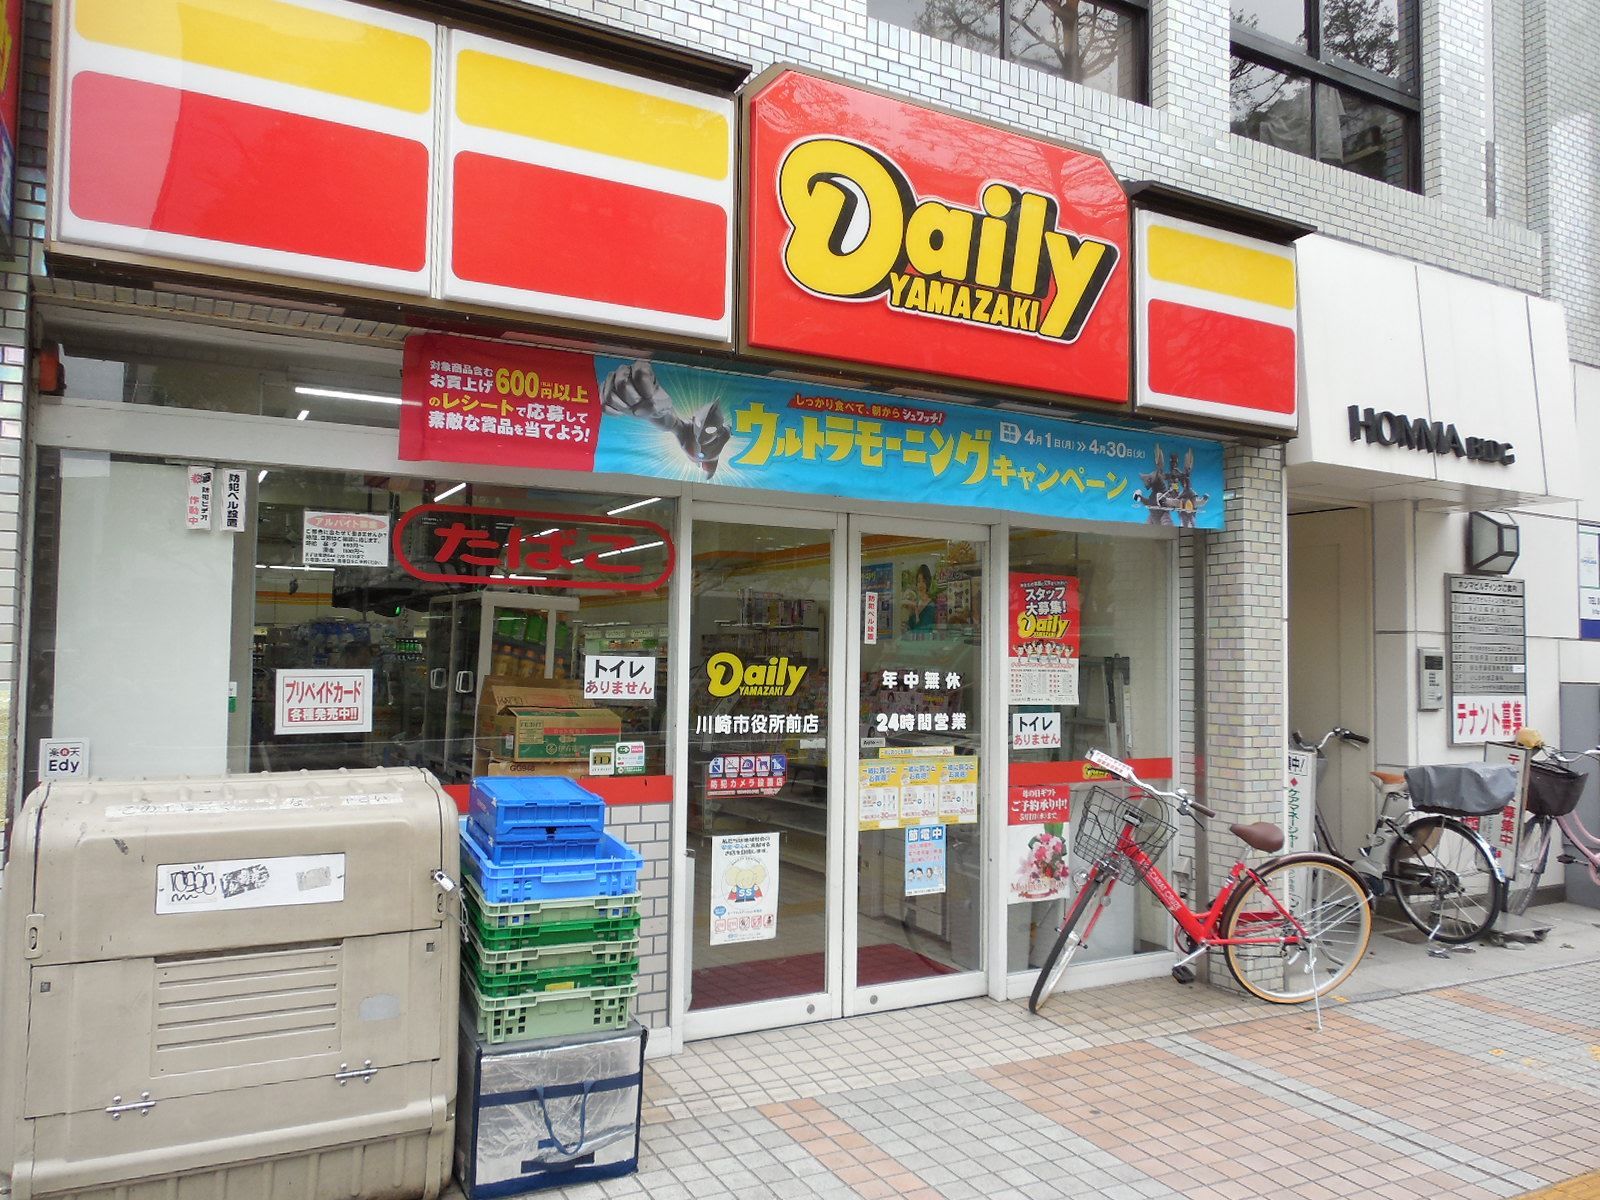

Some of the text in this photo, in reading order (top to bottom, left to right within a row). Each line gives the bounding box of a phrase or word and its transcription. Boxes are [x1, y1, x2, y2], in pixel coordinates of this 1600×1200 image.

[776, 135, 1120, 343] Daily
[888, 271, 1042, 333] YAMAZAKI
[430, 360, 494, 377] 対象商品含む
[734, 402, 992, 486] ウルトラモーニング
[992, 454, 1128, 500] キャンペーン
[434, 522, 642, 574] たばこ
[1025, 587, 1066, 601] スタッフ
[1018, 611, 1070, 638] Daily
[595, 659, 645, 679] トイレ
[706, 652, 808, 697] Daily
[585, 680, 652, 695] ありません
[882, 671, 961, 689] 年中無休
[284, 680, 362, 704] プリペイドカード
[739, 685, 784, 697] YAMAZAKI
[696, 714, 819, 735] 川崎市役所前店
[876, 713, 967, 732] 24時間営業
[1019, 716, 1053, 732] トイレ
[1013, 734, 1060, 746] ありません
[48, 759, 80, 773] Edy
